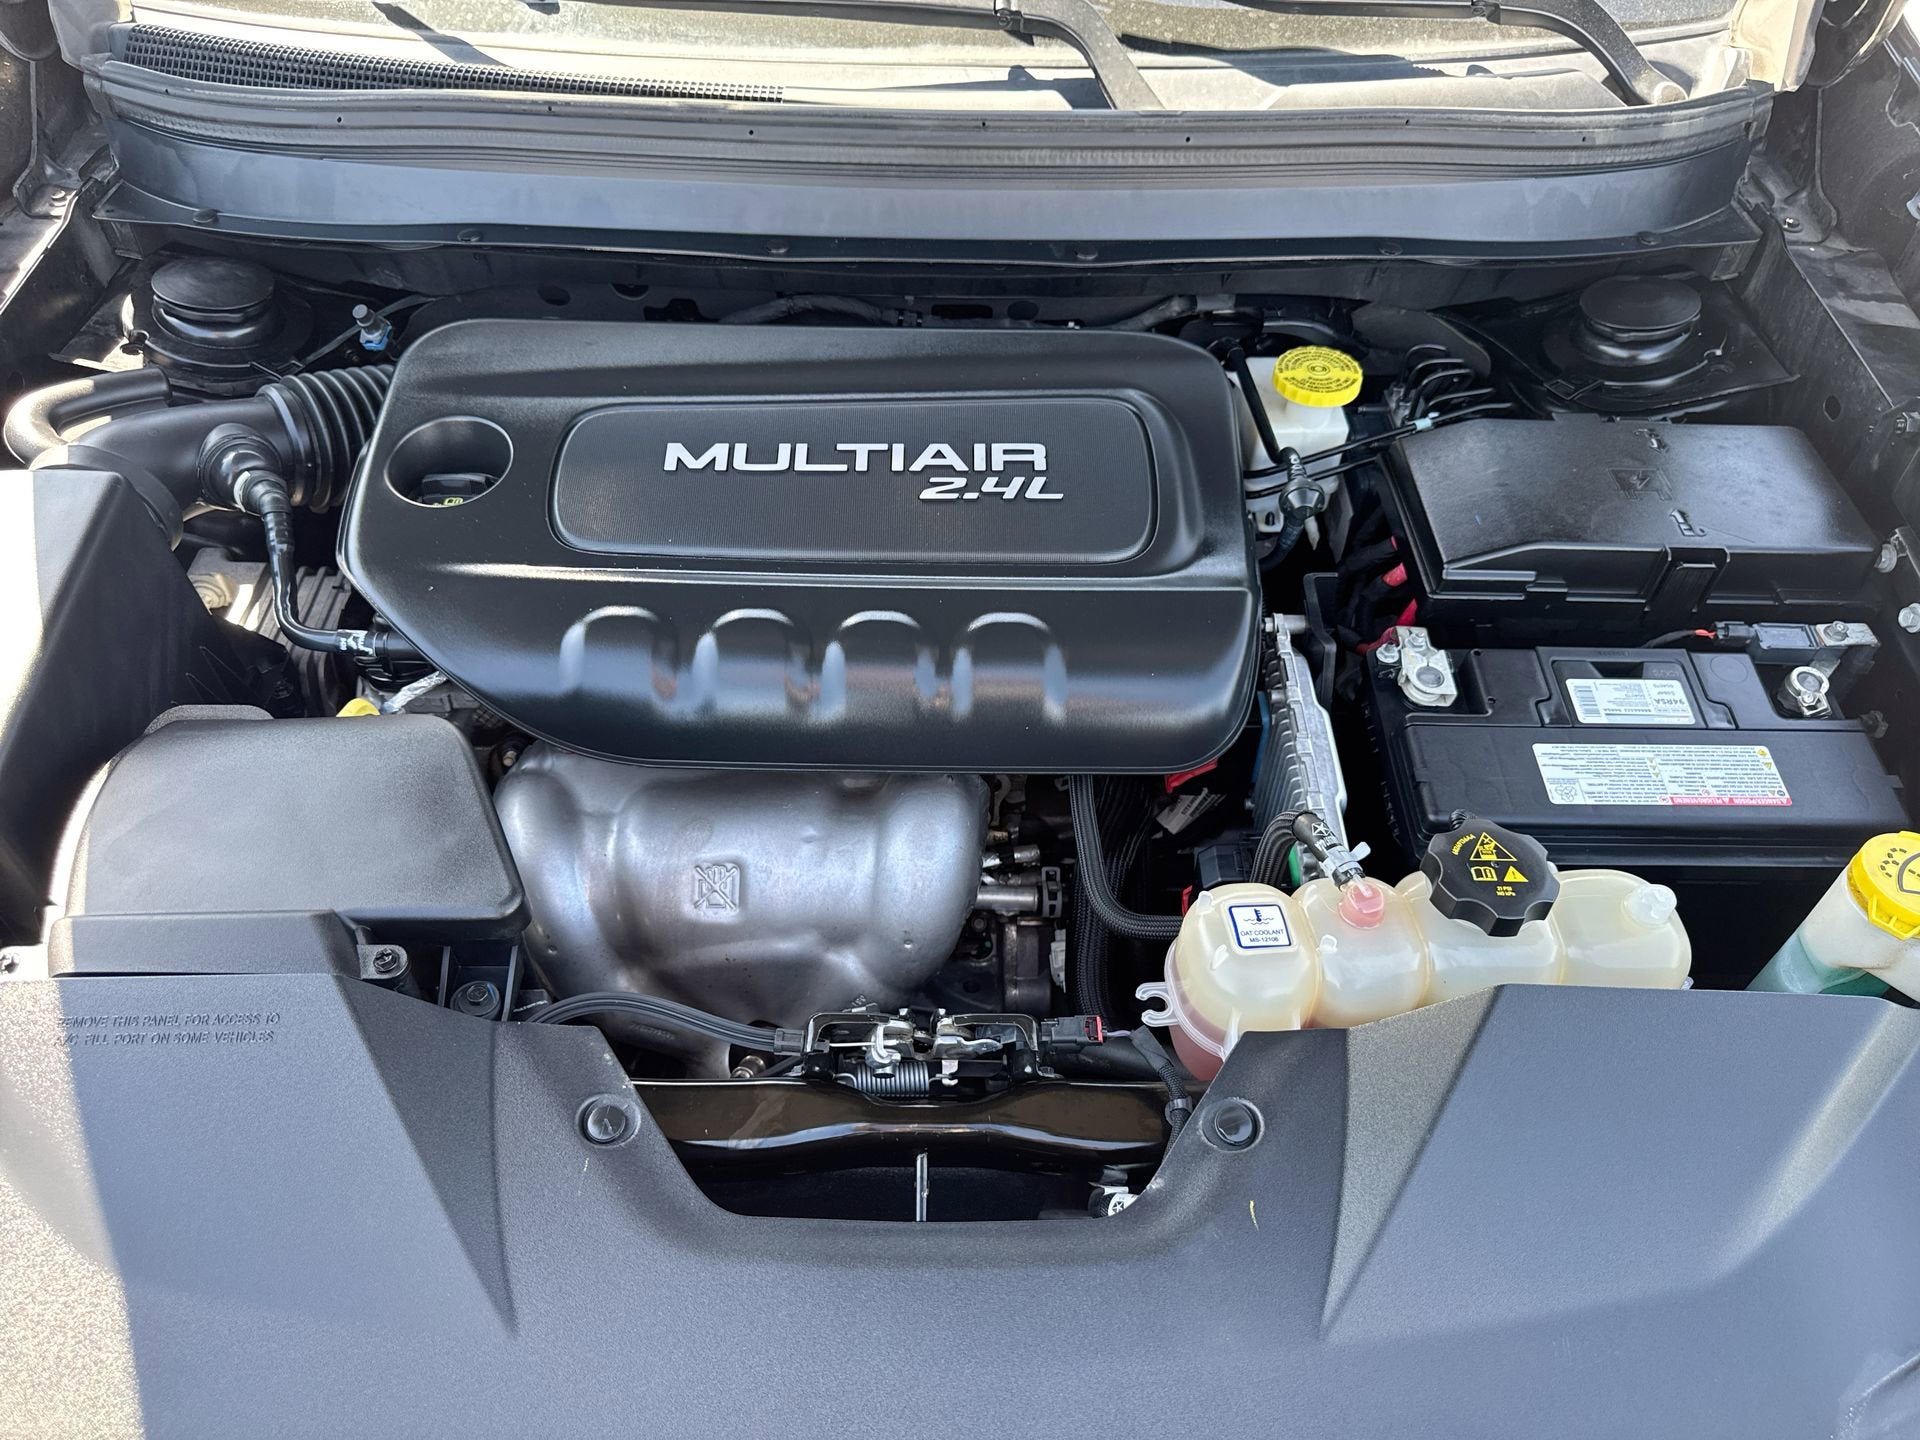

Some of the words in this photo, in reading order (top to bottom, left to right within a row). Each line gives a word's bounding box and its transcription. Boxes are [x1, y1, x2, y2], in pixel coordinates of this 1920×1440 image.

[663, 442, 1049, 473] MULTIAIR
[918, 476, 1065, 500] 2.4L
[58, 1016, 109, 1028] REMOVE
[112, 1015, 140, 1027] THIS
[143, 1015, 181, 1027] PANEL
[185, 1014, 210, 1025] FOR
[212, 1013, 262, 1025] ACCESS
[265, 1012, 280, 1024] TO
[85, 1033, 110, 1046] FILL
[115, 1033, 147, 1045] PORT
[151, 1033, 171, 1045] ON
[173, 1032, 209, 1044] SOME
[215, 1031, 275, 1043] VEHICLES
